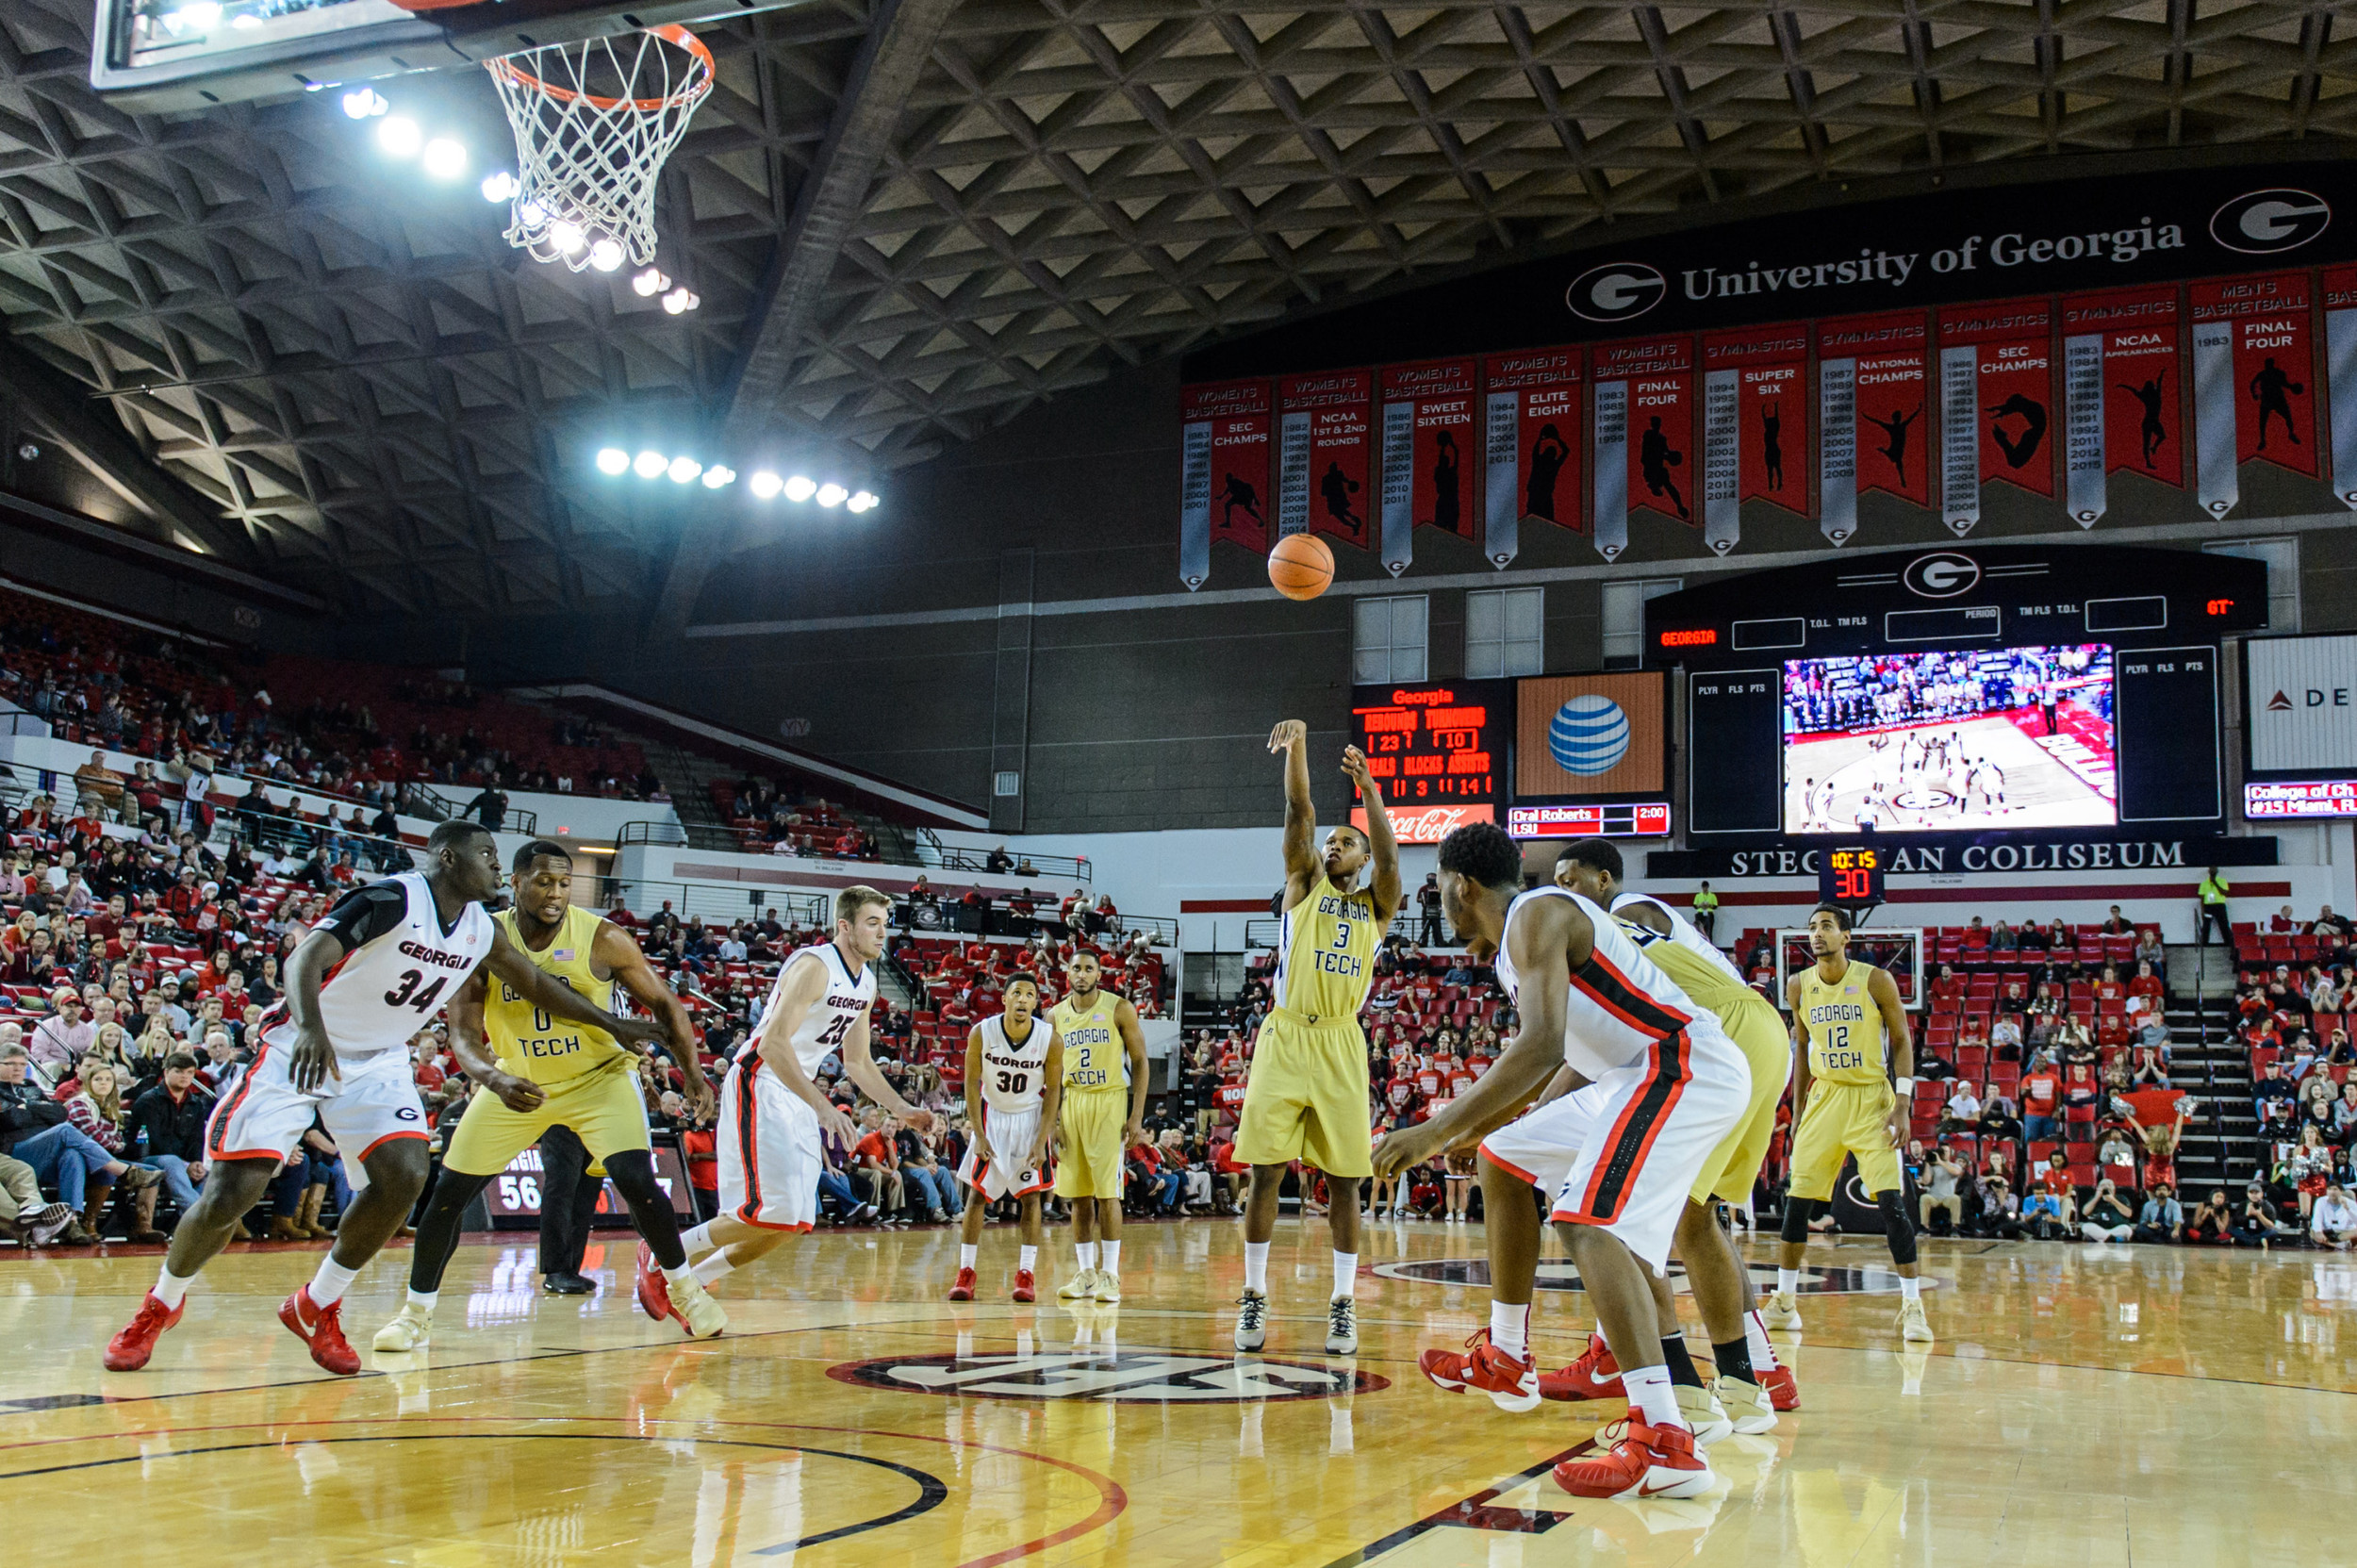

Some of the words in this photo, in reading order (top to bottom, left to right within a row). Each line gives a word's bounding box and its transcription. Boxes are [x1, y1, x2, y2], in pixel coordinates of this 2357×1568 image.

[1682, 247, 1918, 303] University
[1931, 236, 1983, 274] of
[1990, 216, 2185, 272] Georgia
[2222, 283, 2276, 299] MEN'S
[2066, 301, 2176, 322] GYMNASTICS
[2193, 296, 2309, 319] BASKETBALL
[1942, 314, 2049, 334] GYMNASTICS
[2245, 321, 2297, 335] FINAL
[1822, 326, 1924, 346] GYMNASTICS
[2115, 334, 2162, 347] NCAA
[2197, 336, 2229, 348] 1983
[1707, 338, 1805, 357] GYMNASTICS
[2245, 336, 2293, 350] FOUR
[1609, 344, 1677, 360] WOMEN'S
[1999, 346, 2029, 358] SEC
[2105, 346, 2173, 358] APPEARANCES
[1502, 356, 1567, 371] WOMEN'S
[1596, 358, 1690, 377] BASKETBALL
[1859, 357, 1921, 371] NATIONAL
[1981, 358, 2048, 373] CHAMPS
[1397, 367, 1460, 383] WOMEN'S
[1489, 370, 1580, 388] BASKETBALL
[1744, 369, 1795, 383] SUPER
[1858, 370, 1923, 386] CHAMPS
[1295, 378, 1357, 393] WOMEN'S
[1384, 380, 1473, 399] BASKETBALL
[1638, 381, 1681, 393] FINAL
[1709, 384, 1736, 393] 1994
[1757, 384, 1781, 395] SIX
[1197, 388, 1258, 403] WOMEN'S
[1283, 390, 1368, 408] BASKETBALL
[1529, 390, 1569, 404] ELITE
[1599, 391, 1624, 401] 1983
[1638, 394, 1677, 406] FOUR
[1709, 394, 1736, 404] 1995
[1185, 401, 1268, 419] BASKETBALL
[1422, 401, 1467, 415] SWEET
[1491, 403, 1515, 411] 1984
[1528, 404, 1571, 417] EIGHT
[1599, 403, 1624, 411] 1985
[1709, 405, 1736, 414] 1996
[1321, 412, 1358, 423] NCAA
[1387, 413, 1410, 421] 1986
[1417, 413, 1471, 427] SIXTEEN
[1599, 413, 1624, 422] 1995
[1709, 416, 1735, 424] 1997
[1228, 422, 1254, 433] SEC
[1284, 424, 1309, 433] 1982
[1313, 427, 1331, 437] 1ST
[1333, 426, 1342, 435] &
[1343, 424, 1367, 434] 2ND
[1387, 423, 1410, 432] 1987
[1491, 423, 1515, 432] 1997
[1599, 424, 1624, 433] 1996
[1707, 426, 1736, 436] 2000
[1214, 433, 1268, 446] CHAMPS
[1284, 434, 1309, 442] 1989
[1317, 437, 1360, 448] ROUNDS
[1489, 434, 1515, 443] 2000
[1599, 435, 1624, 444] 1999
[1707, 437, 1734, 446] 2001
[1284, 444, 1308, 453] 1990
[1385, 444, 1410, 453] 2003
[1489, 444, 1515, 453] 2004
[1707, 448, 1736, 457] 2002
[1284, 454, 1307, 463] 1993
[1385, 454, 1411, 463] 2005
[1489, 455, 1515, 464] 2013
[1707, 458, 1736, 468] 2003
[1385, 464, 1410, 472] 2006
[1707, 470, 1736, 479] 2004
[1282, 474, 1306, 483] 2001
[1384, 474, 1410, 483] 2007
[1707, 480, 1736, 489] 2013
[1282, 485, 1307, 493] 2002
[1384, 485, 1409, 494] 2010
[1707, 490, 1736, 501] 2014
[1282, 495, 1307, 503] 2008
[1384, 495, 1406, 504] 2011
[1282, 504, 1307, 514] 2009
[1282, 515, 1306, 524] 2012
[1282, 525, 1307, 535] 2014
[1965, 608, 1997, 619] PERIOD
[2019, 606, 2034, 616] TM
[2035, 605, 2051, 615] FLS
[2056, 604, 2080, 614] T.O.L.
[1810, 619, 1831, 628] T.O.L.
[1838, 618, 1851, 626] TM
[1852, 617, 1867, 626] FLS
[1661, 630, 1717, 647] GEORGIA
[2126, 664, 2149, 674] PLYR
[2157, 663, 2174, 673] FLS
[2185, 661, 2203, 671] PTS
[1698, 685, 1718, 696] PLYR
[1728, 685, 1743, 694] FLS
[1750, 684, 1765, 693] PTS
[1393, 688, 1454, 707] Georgia
[1364, 711, 1417, 732] REBOUNDS
[1380, 734, 1399, 751] 23
[1445, 732, 1465, 749] 10
[1367, 756, 1396, 777] TEALS
[1403, 754, 1444, 776] BLOCKS
[1447, 752, 1490, 773] ASSISTS
[1416, 780, 1428, 797] 3
[1459, 778, 1479, 795] 14
[2250, 785, 2307, 801] College
[2310, 784, 2329, 798] of
[2250, 801, 2285, 815] #15
[2287, 800, 2338, 815] Miami,
[1513, 808, 1539, 822] Oral
[1541, 807, 1591, 821] Roberts
[1640, 807, 1664, 819] 2:00
[1513, 822, 1538, 835] LSU
[1731, 847, 1946, 875] STEGAN
[1962, 841, 2184, 871] COLISEUM
[1831, 850, 1877, 869] 10:15
[1835, 868, 1871, 898] 30
[1318, 896, 1369, 923] GEORGIA
[1333, 922, 1350, 949] 3
[1314, 949, 1361, 977] TECH
[384, 969, 448, 1014] 34
[1810, 1003, 1863, 1026] GEORGIA
[815, 1014, 855, 1045] 25
[1063, 1027, 1110, 1048] GEORGIA
[1827, 1027, 1849, 1048] 12
[518, 1035, 580, 1057] TECH
[984, 1052, 1043, 1069] GEORGIA
[1080, 1048, 1092, 1068] 2
[1820, 1050, 1863, 1069] TECH
[996, 1070, 1029, 1095] 30
[1070, 1069, 1107, 1085] TECH
[499, 1175, 541, 1211] 56
